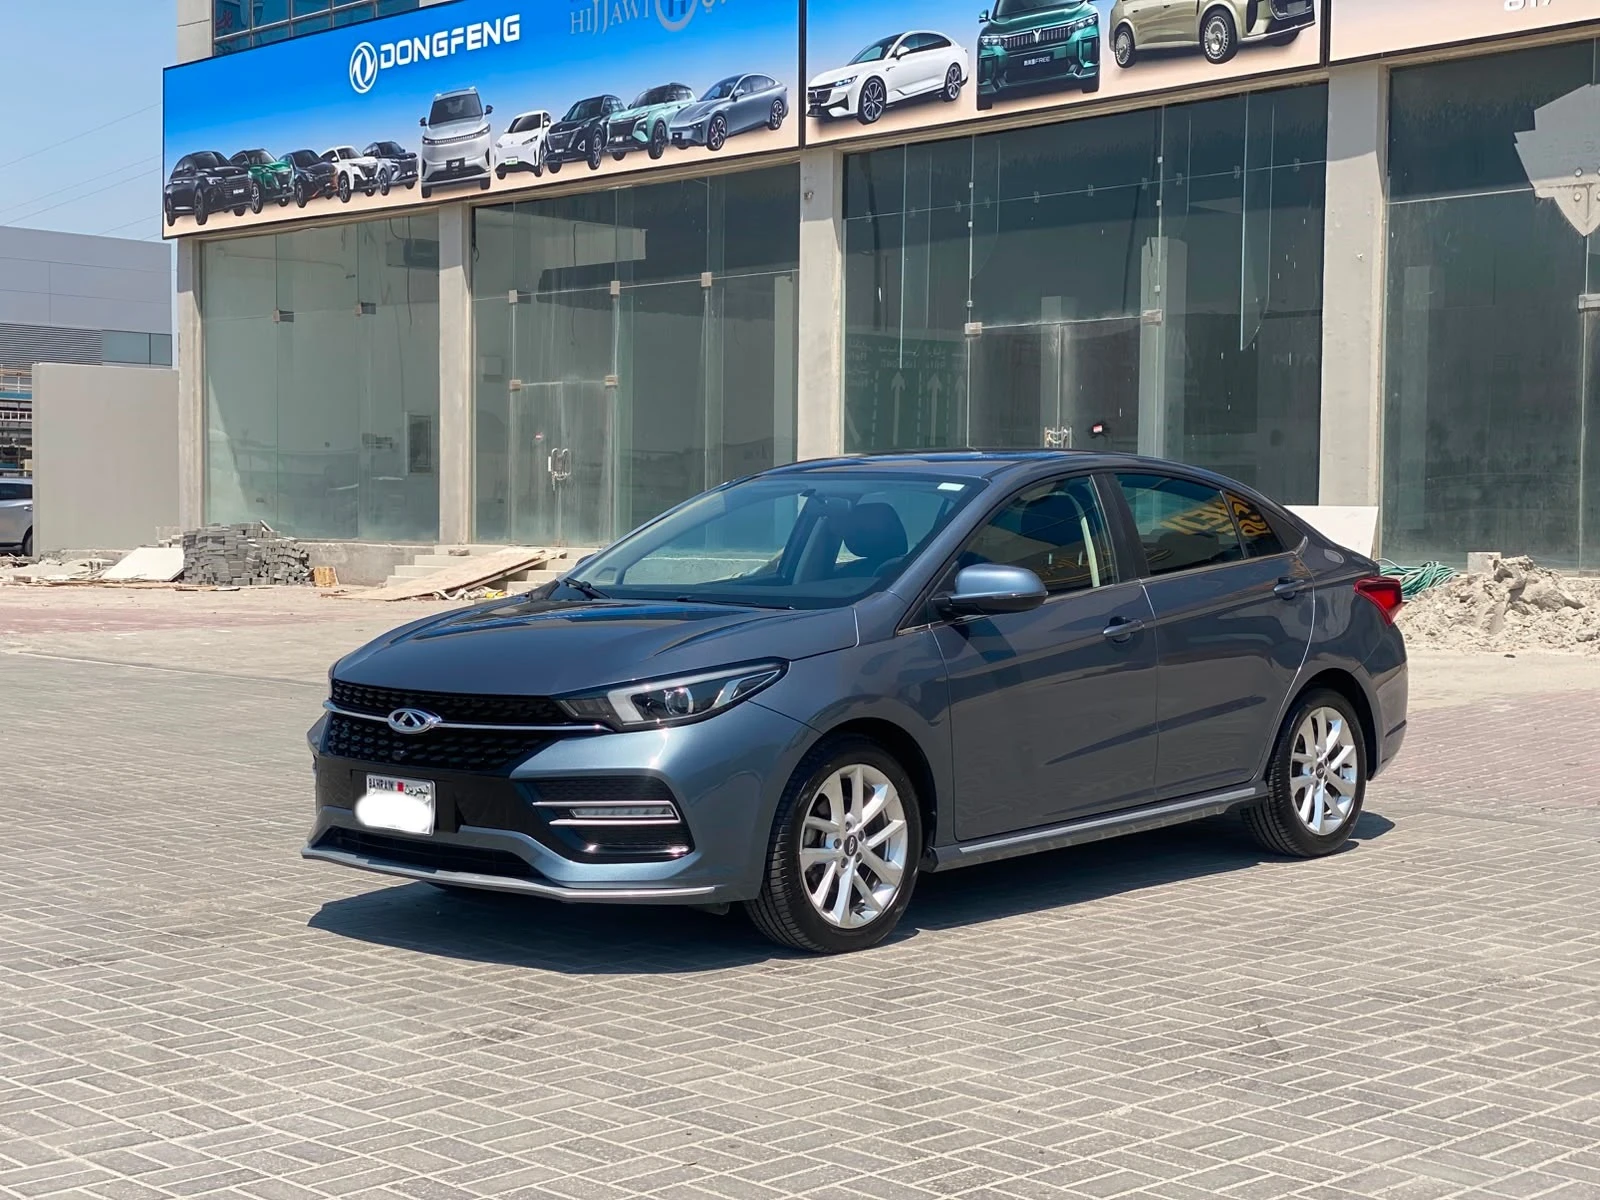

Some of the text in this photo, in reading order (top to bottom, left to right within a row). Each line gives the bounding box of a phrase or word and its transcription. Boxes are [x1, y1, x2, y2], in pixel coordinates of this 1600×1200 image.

[570, 0, 649, 35] HIJJAWI
[380, 14, 521, 69] DONGFENG
[368, 778, 395, 792] BAHRAIN
